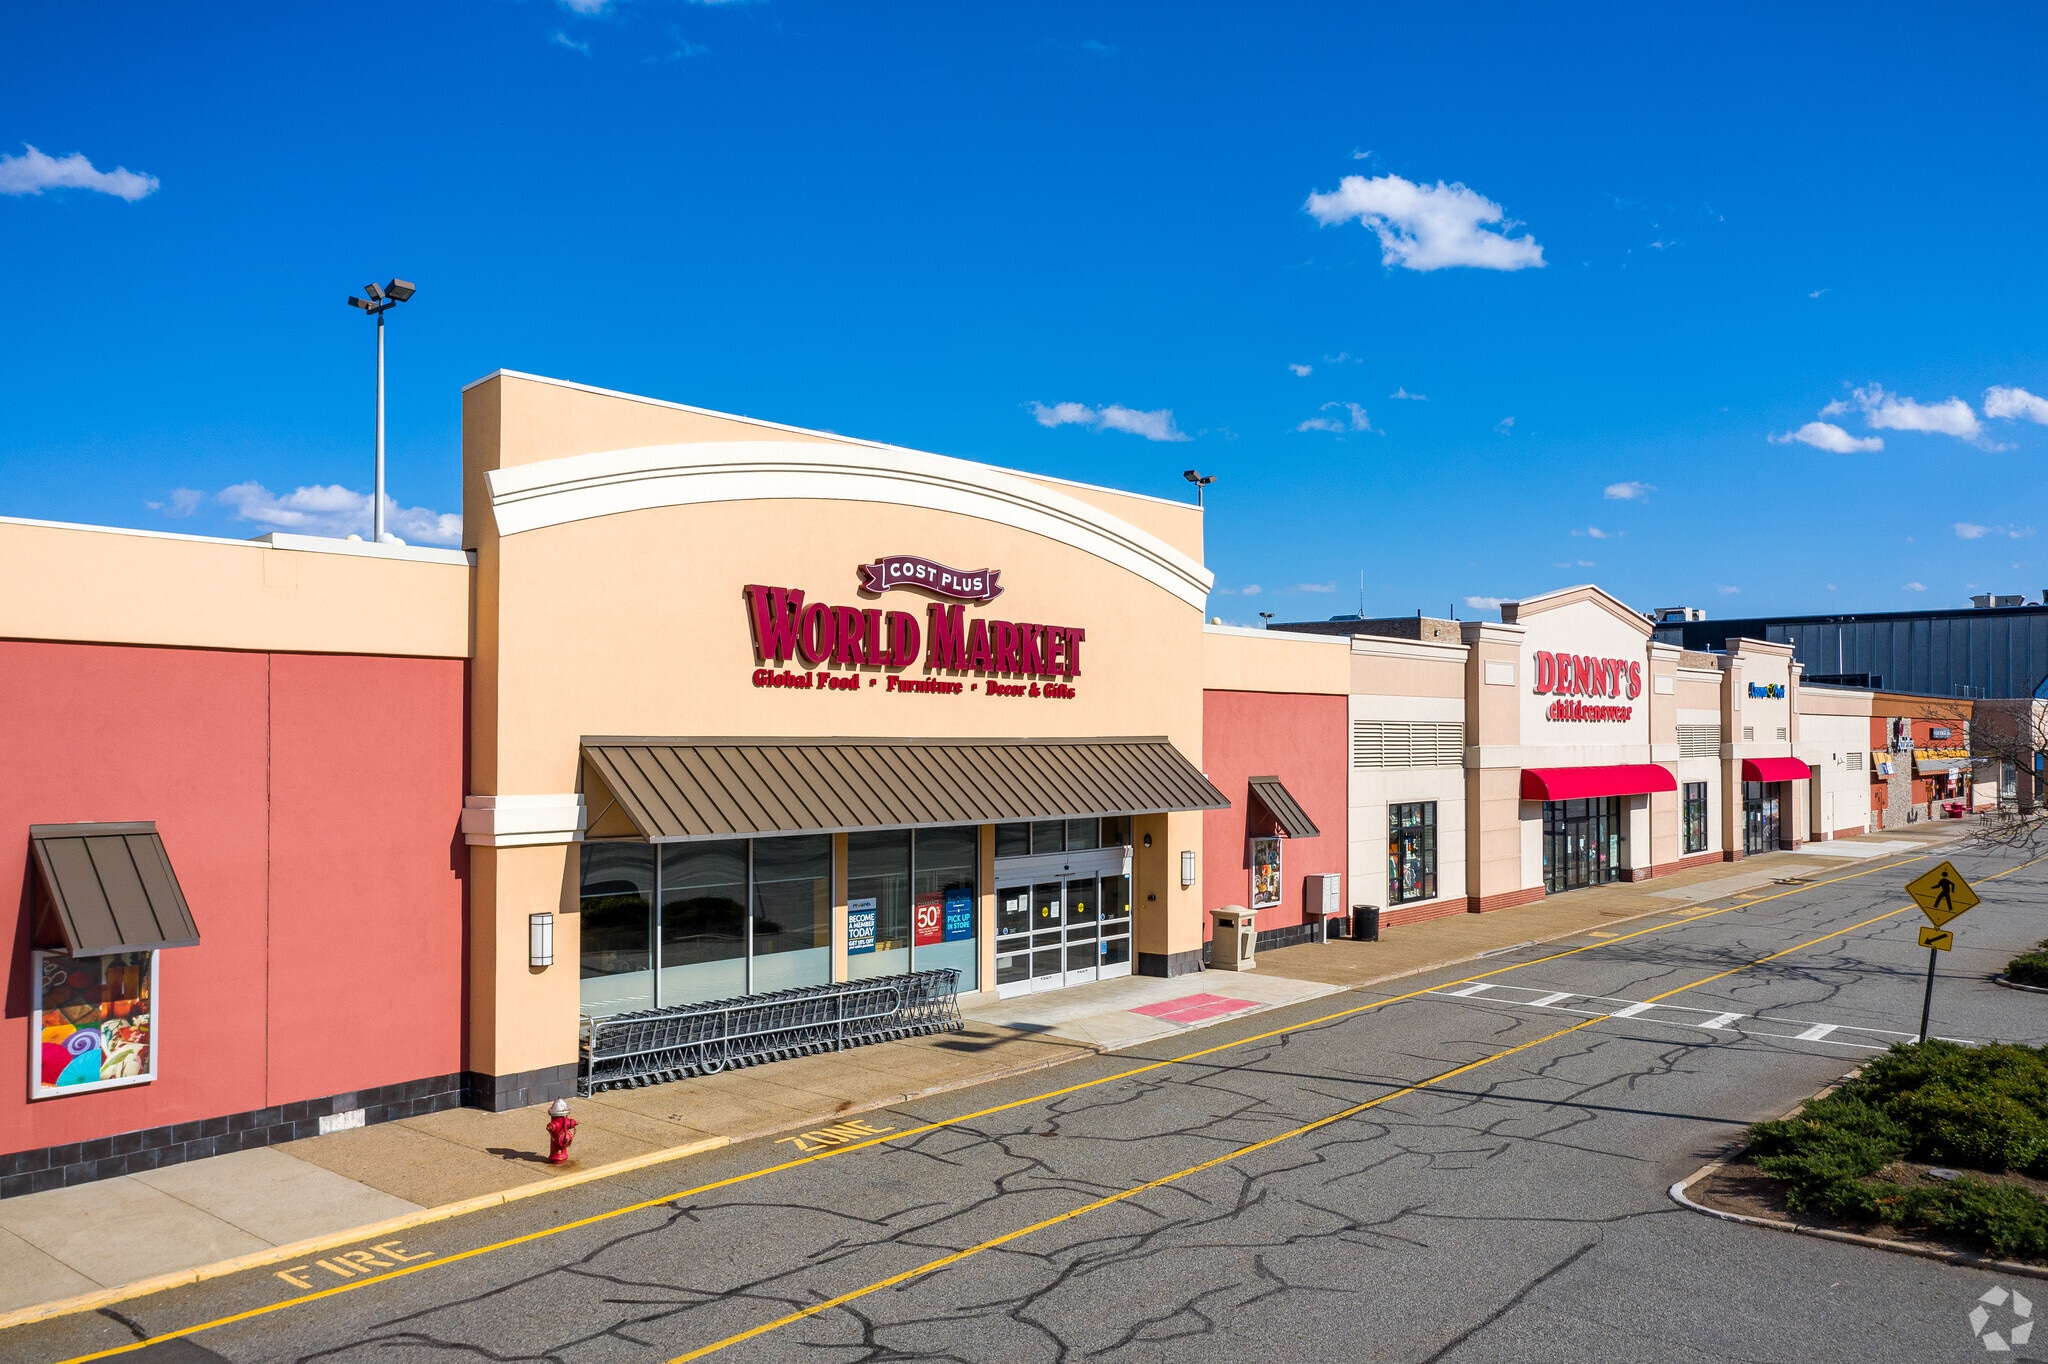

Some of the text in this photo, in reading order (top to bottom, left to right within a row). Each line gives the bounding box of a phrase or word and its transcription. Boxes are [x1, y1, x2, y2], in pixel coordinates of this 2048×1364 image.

[889, 562, 983, 592] COST PLUS
[743, 584, 1085, 676] WORLD MARKET
[752, 669, 1076, 699] Global Food Furniture Decor & Gifts
[1534, 650, 1642, 699] DENNY'S
[1547, 699, 1632, 721] childrenswear
[849, 913, 875, 923] BECOME
[854, 920, 875, 928] MEMBER
[917, 906, 937, 928] 50
[947, 913, 971, 923] PICK UP
[953, 920, 970, 929] STORE
[848, 927, 875, 938] TODAY
[774, 1119, 896, 1152] ZONE
[273, 1240, 436, 1290] FIRE
